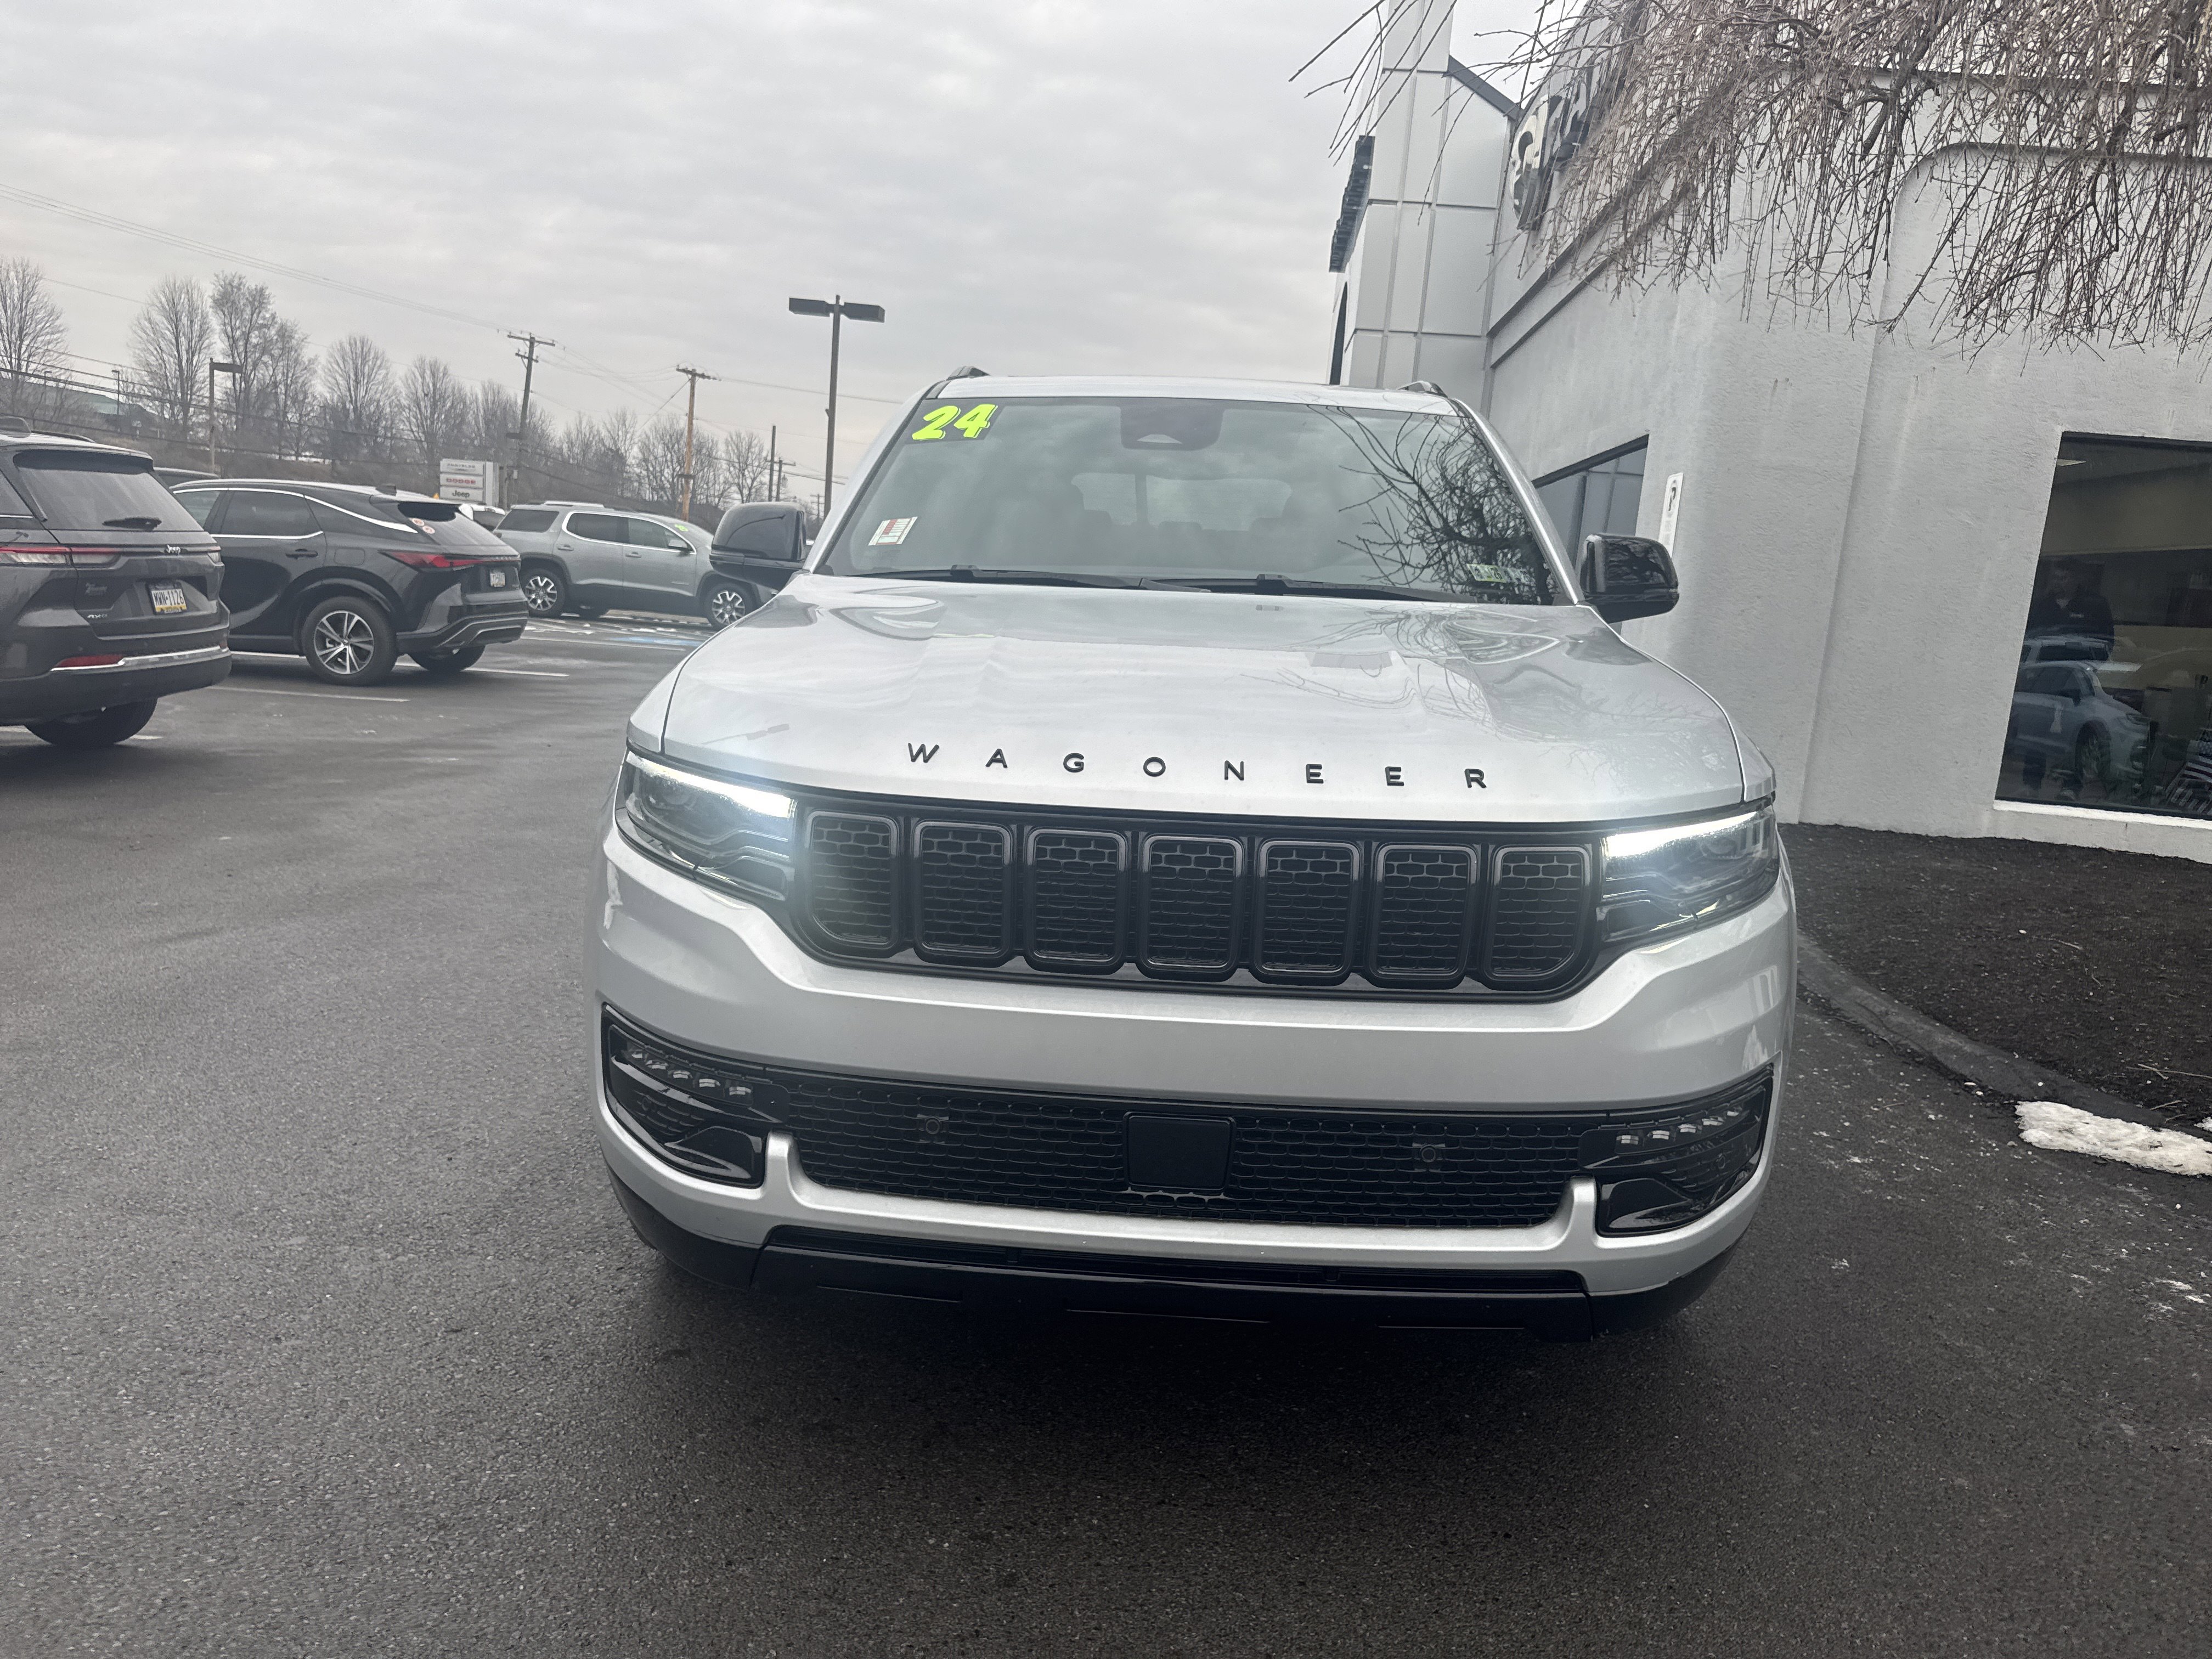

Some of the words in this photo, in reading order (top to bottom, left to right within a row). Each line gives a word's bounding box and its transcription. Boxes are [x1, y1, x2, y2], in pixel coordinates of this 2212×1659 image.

[912, 404, 998, 441] 24
[452, 490, 470, 498] Jeep
[166, 544, 181, 555] Jeep
[907, 742, 1488, 789] WAGONEER
